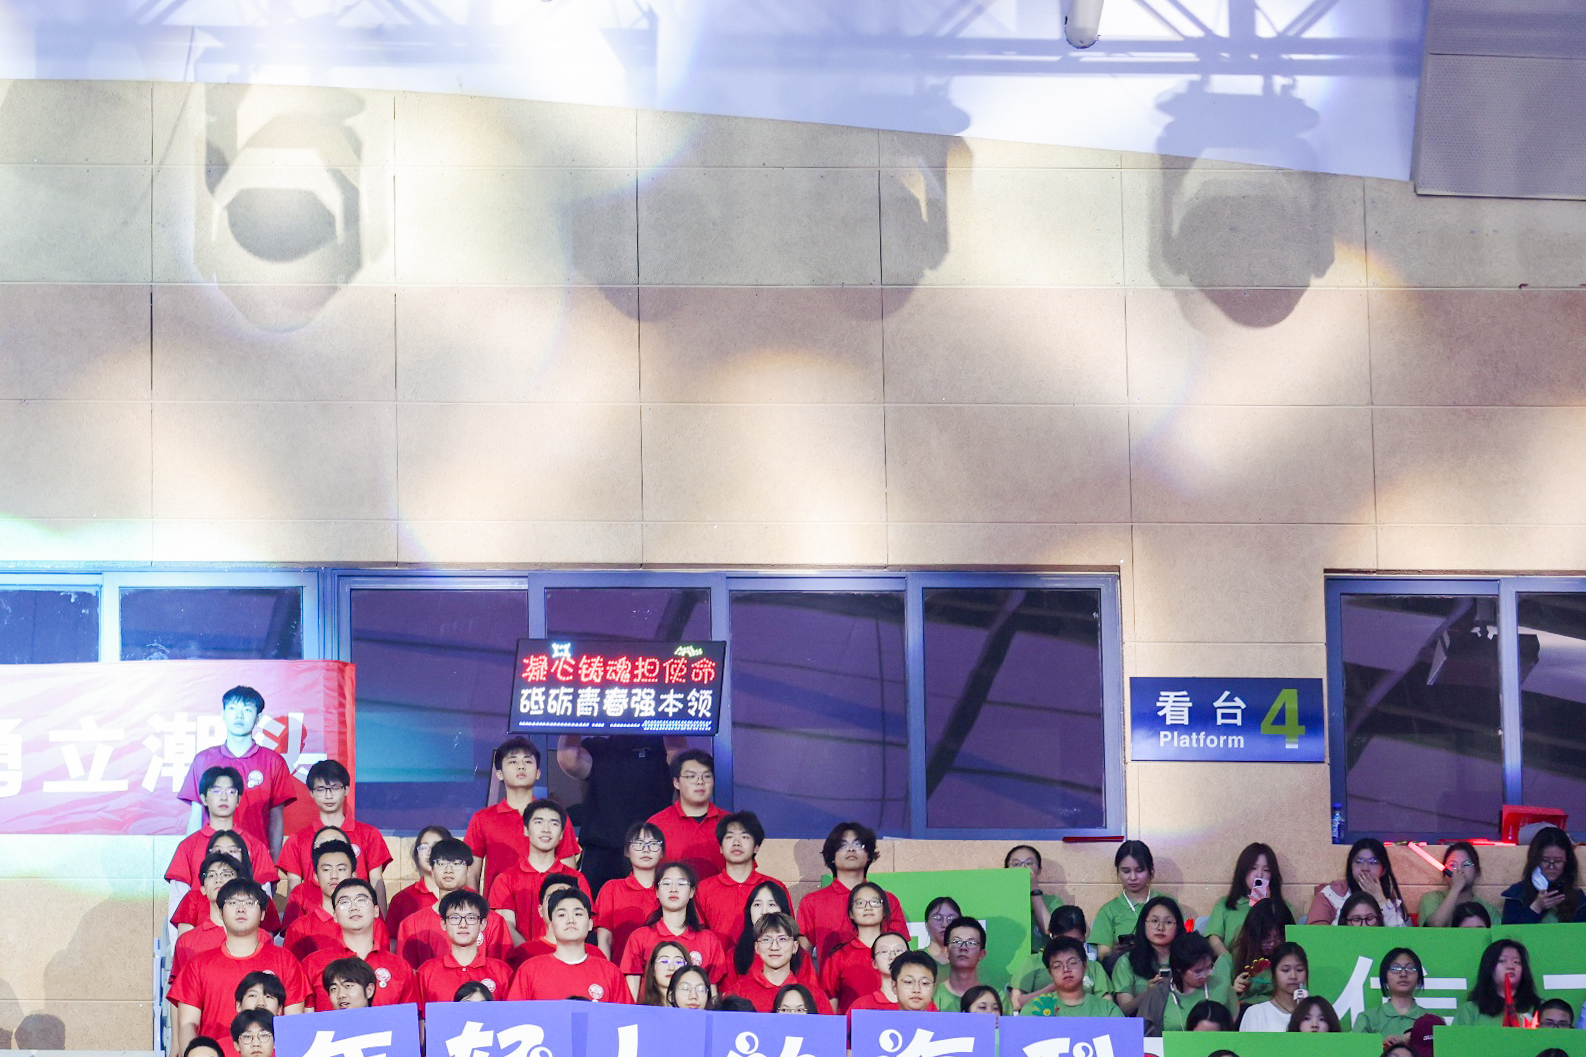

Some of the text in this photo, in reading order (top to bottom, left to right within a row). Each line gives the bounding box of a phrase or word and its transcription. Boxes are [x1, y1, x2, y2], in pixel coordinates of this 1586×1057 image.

[521, 654, 717, 685] 凝心铸魂担使命
[519, 686, 714, 718] 砥砺青春强本领
[1156, 690, 1247, 726] 看台
[1261, 689, 1306, 749] 4
[1158, 730, 1246, 749] Platform
